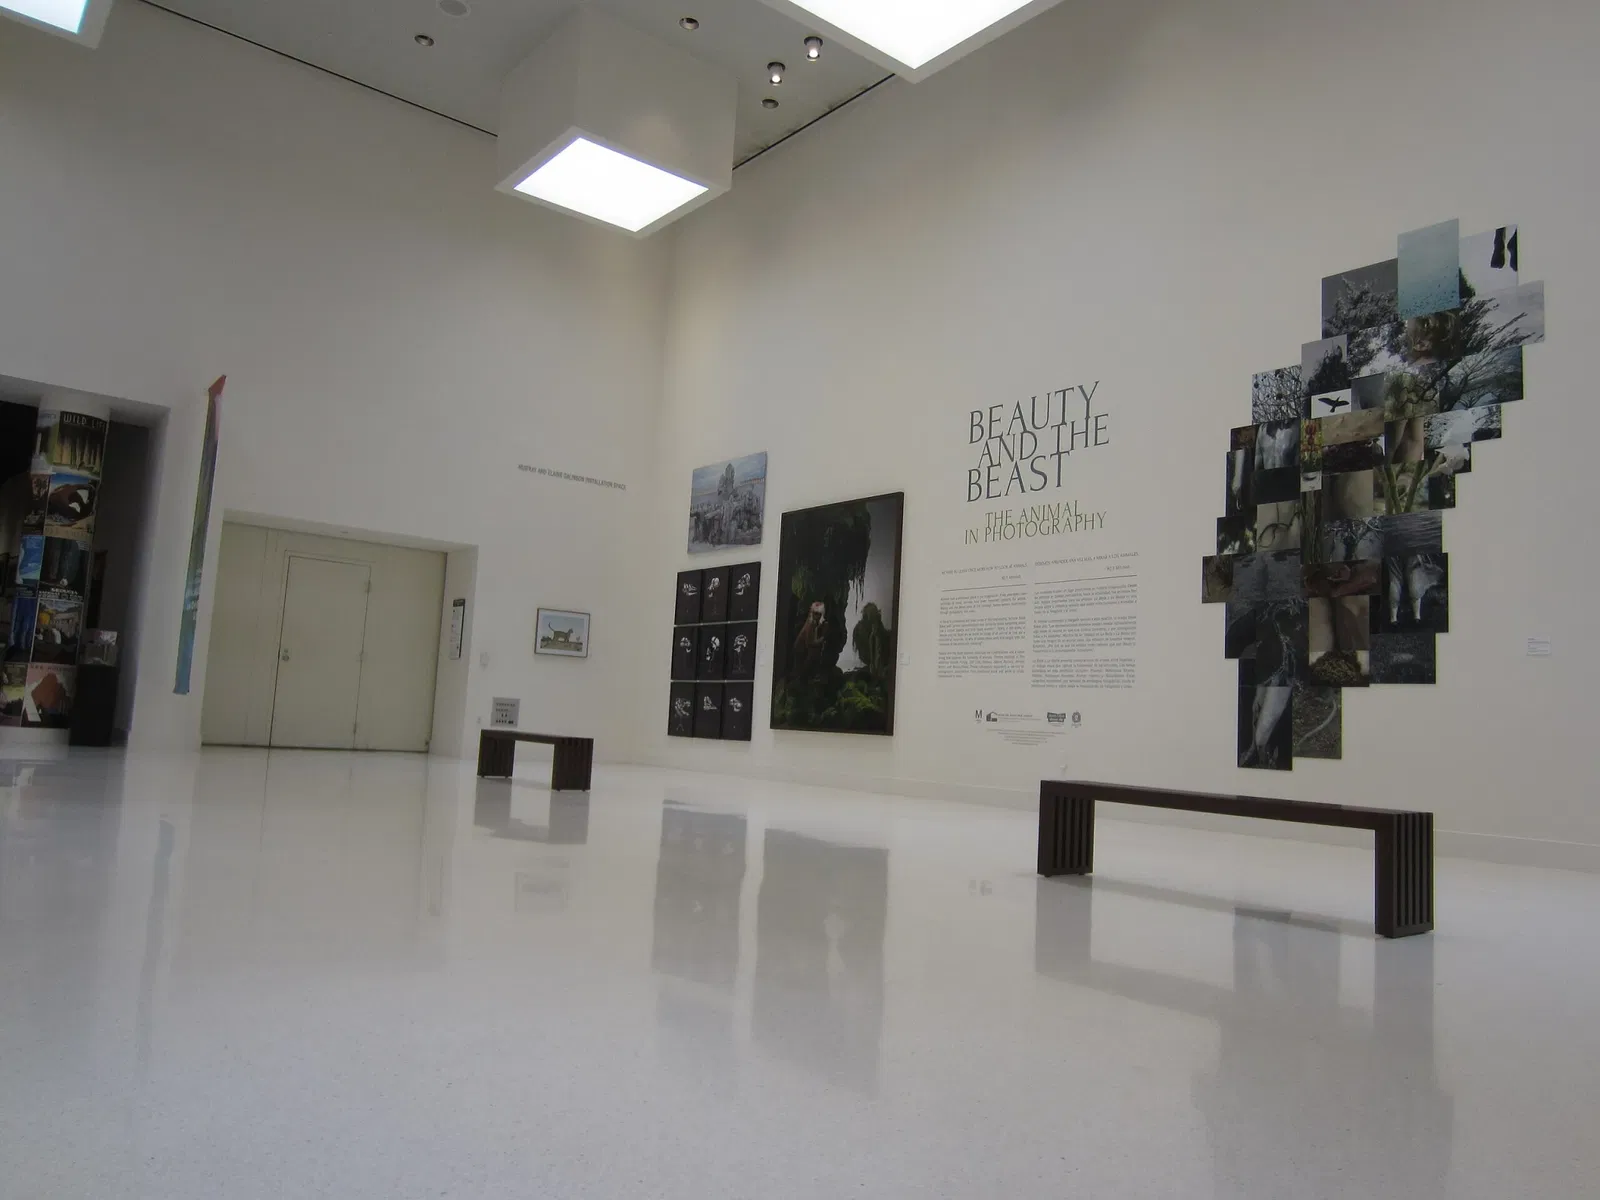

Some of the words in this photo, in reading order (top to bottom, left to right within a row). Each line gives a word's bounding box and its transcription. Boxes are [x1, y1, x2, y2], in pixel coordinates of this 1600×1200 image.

[63, 412, 87, 425] WILD
[969, 380, 1100, 444] BEAUTY
[978, 430, 1038, 469] AND
[1051, 413, 1110, 453] THE
[967, 450, 1071, 502] BEAST
[965, 528, 979, 545] IN
[984, 511, 1107, 543] PHOTOGRAPHY
[985, 509, 1013, 527] THE
[1020, 500, 1083, 523] ANIMAL
